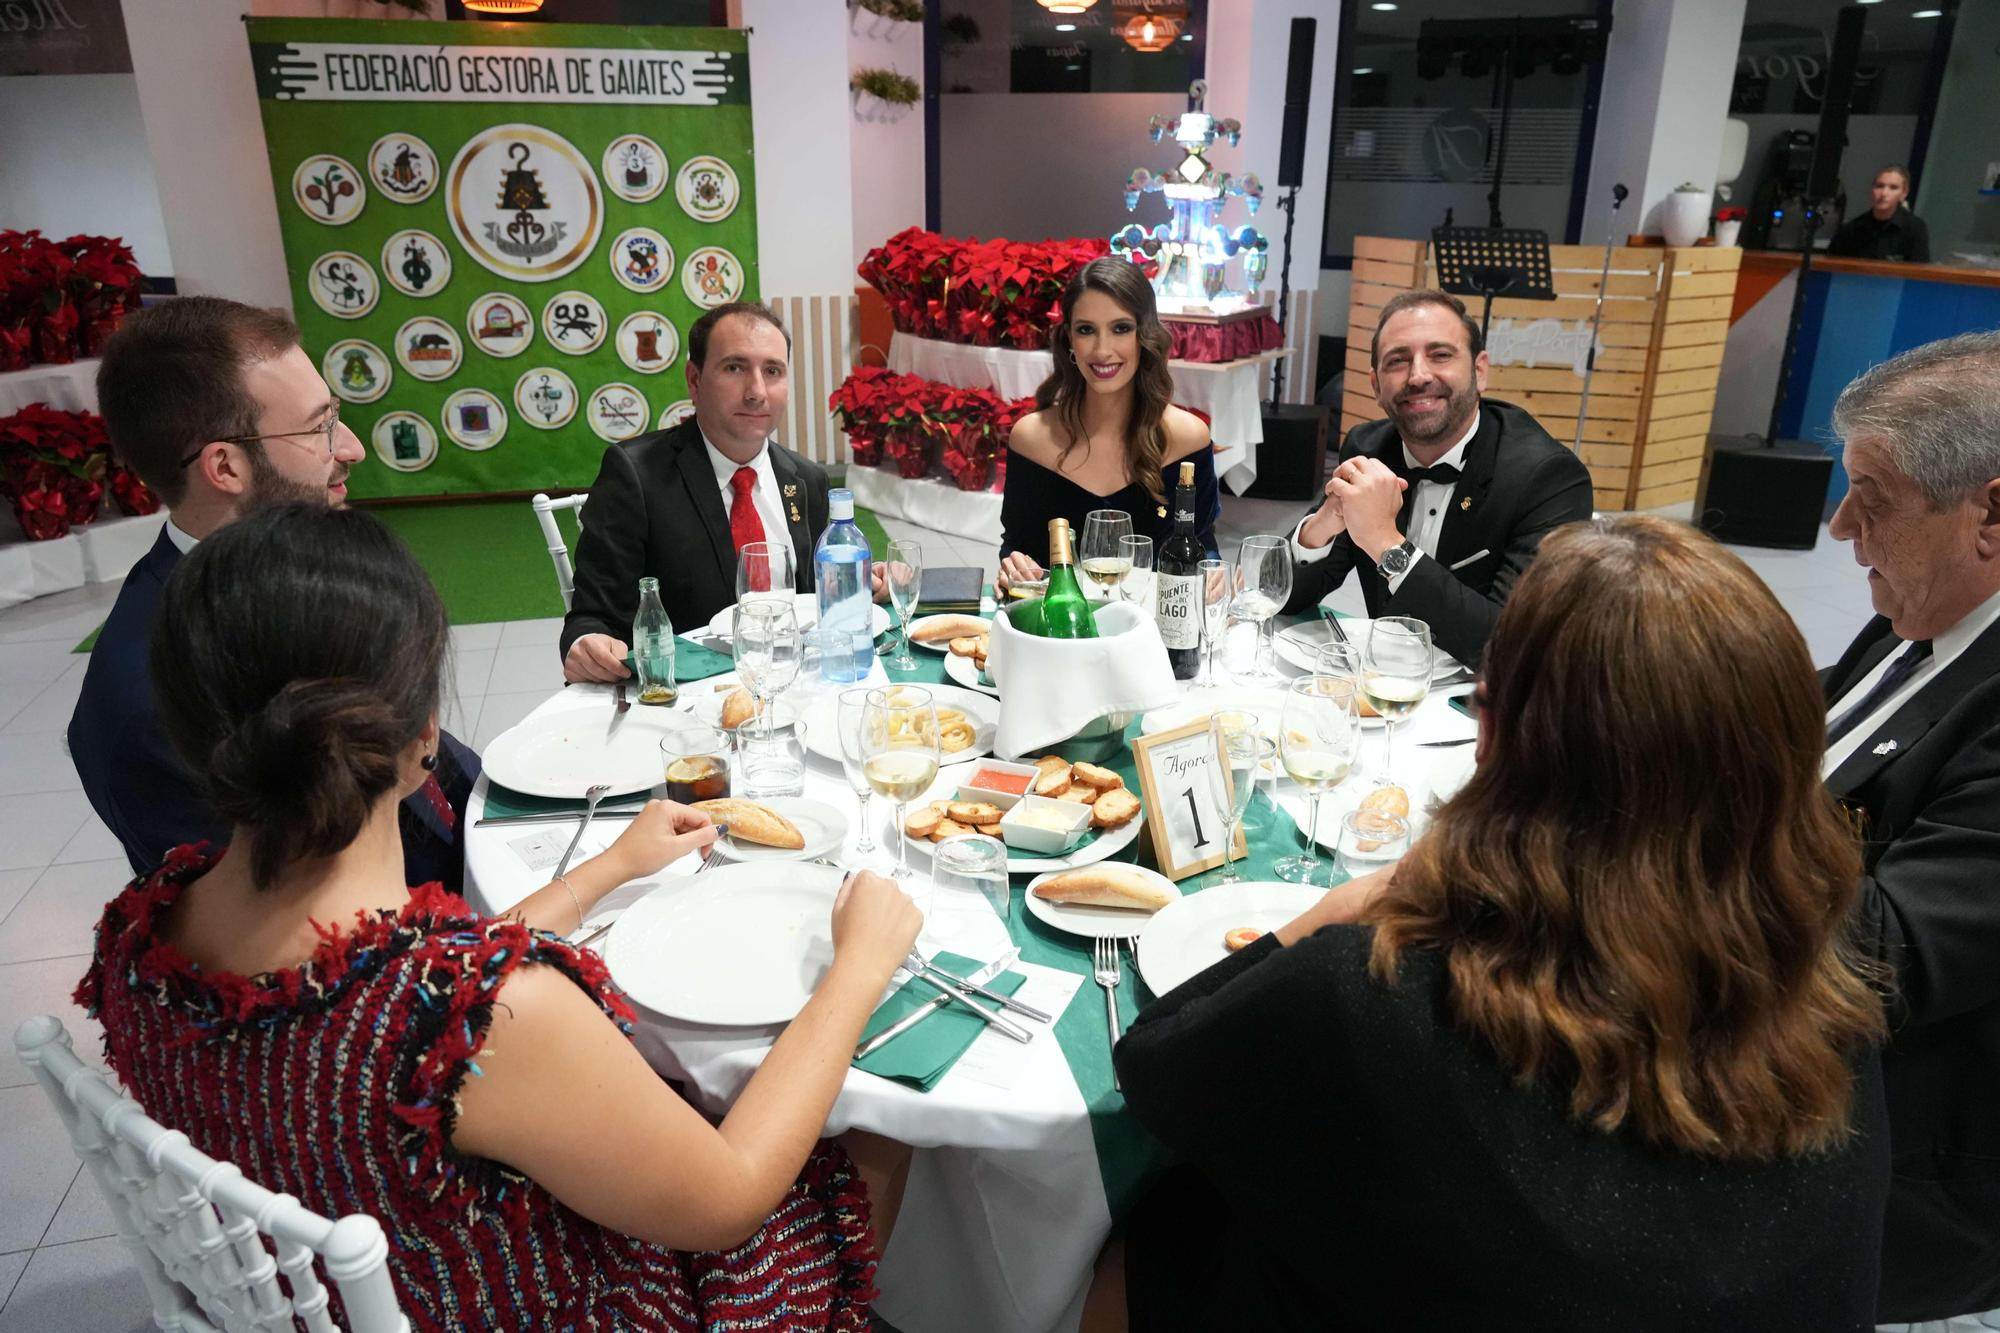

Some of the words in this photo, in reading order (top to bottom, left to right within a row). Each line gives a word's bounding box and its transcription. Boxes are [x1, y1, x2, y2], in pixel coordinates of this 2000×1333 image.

[325, 46, 450, 92] FEDERACIÓ
[458, 56, 560, 93] GESTORA
[566, 58, 594, 94] DE
[600, 58, 685, 95] GAIATES
[1160, 583, 1189, 600] PUENTE
[1160, 601, 1187, 618] LAGO
[1182, 786, 1210, 849] 1
